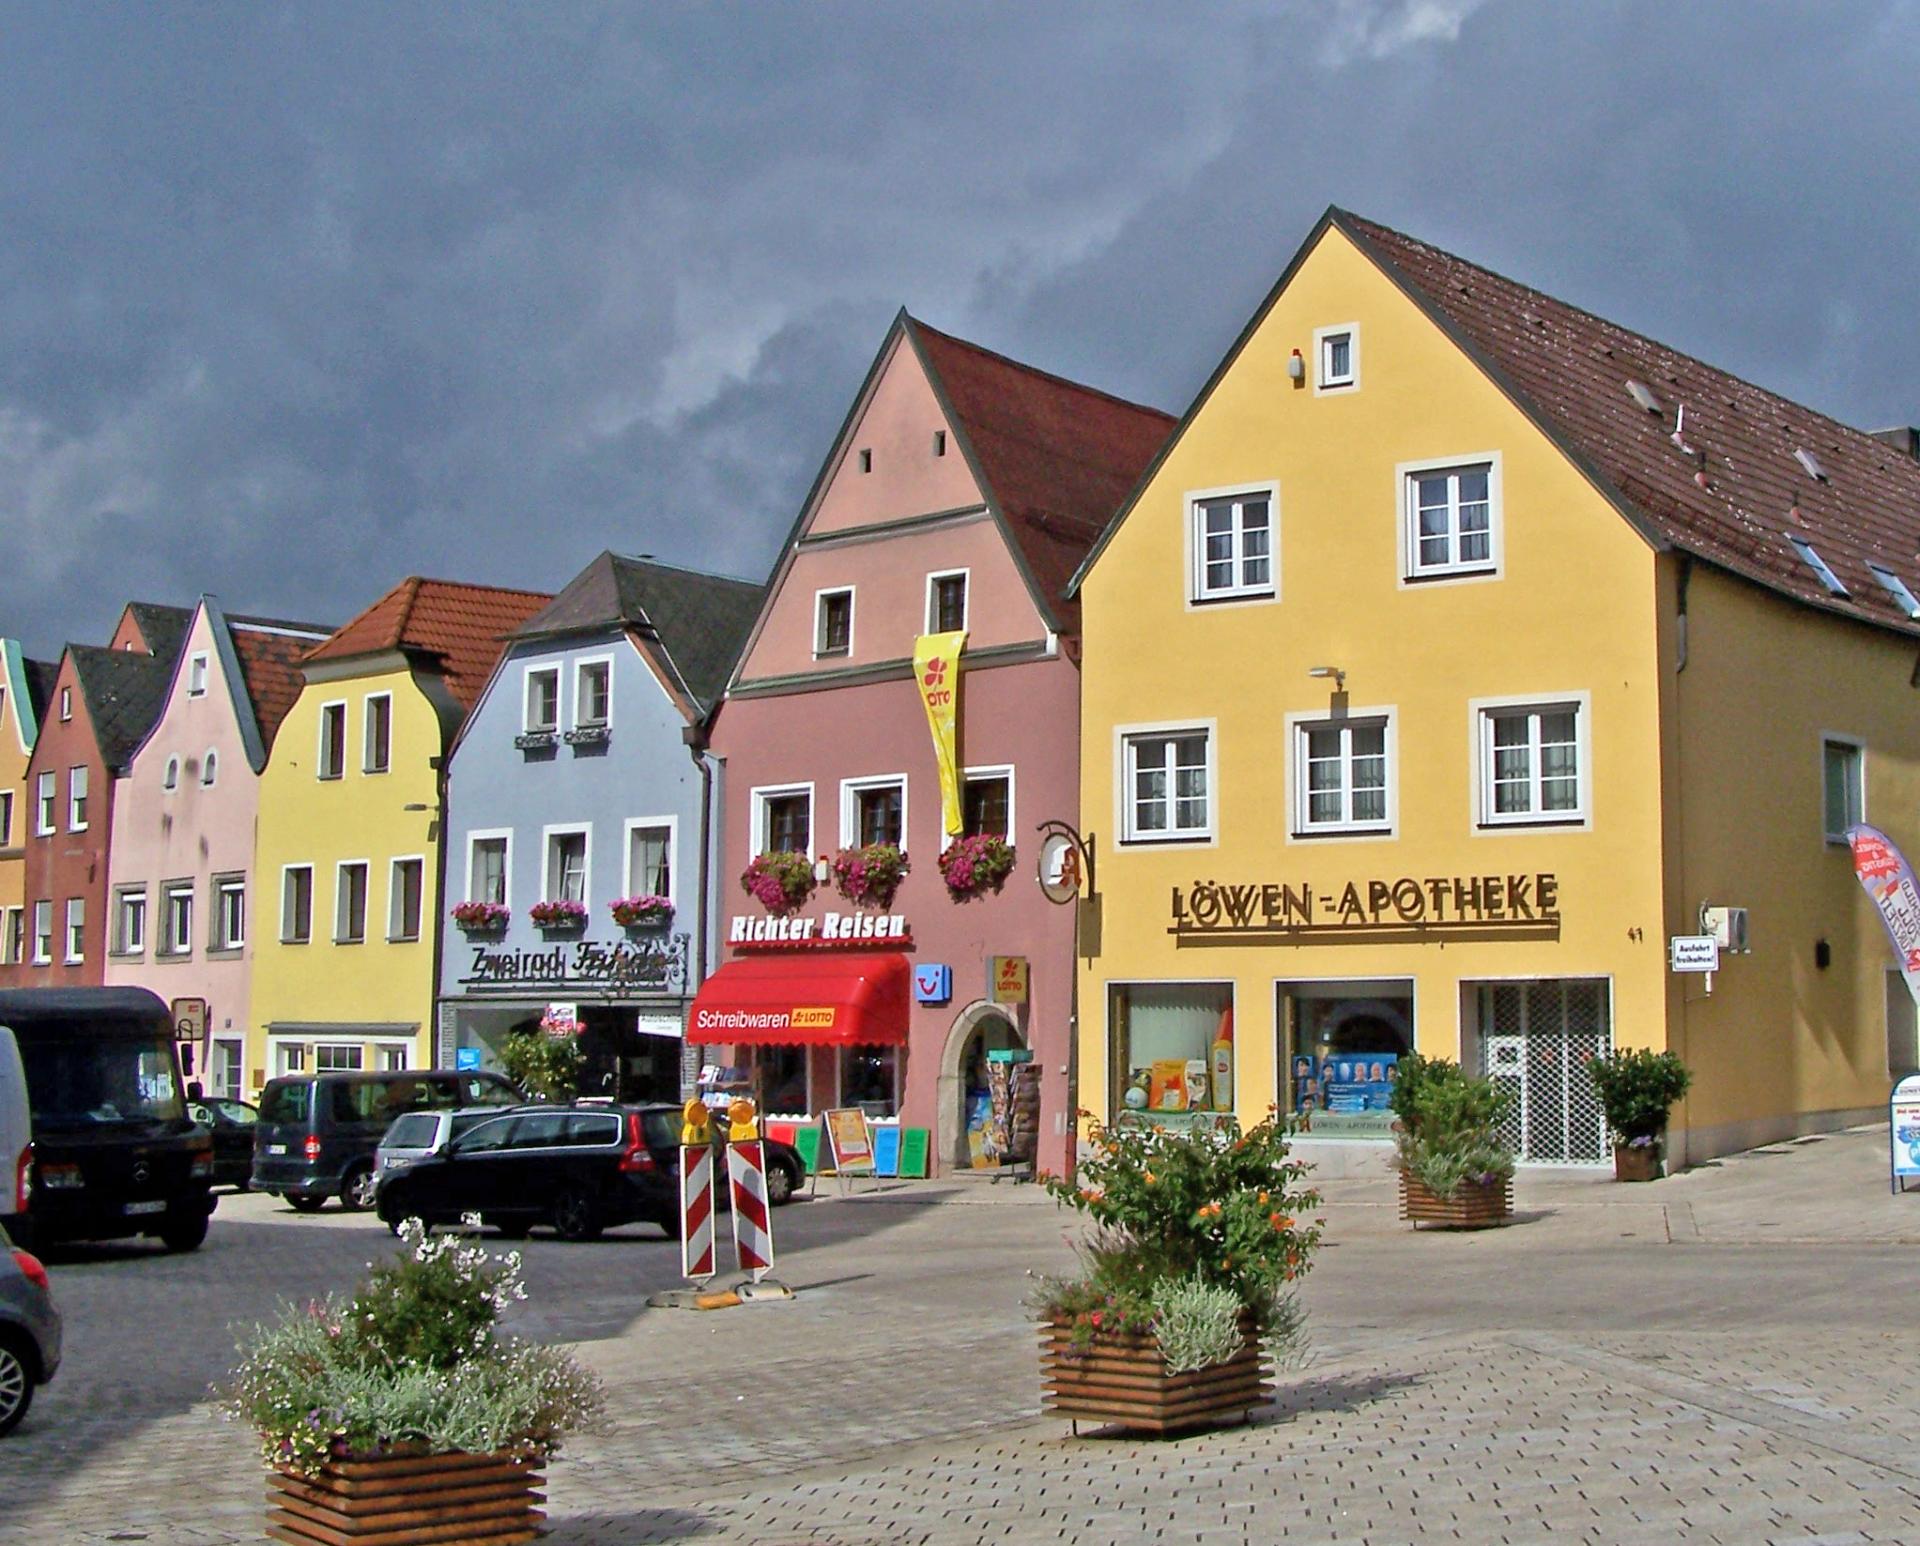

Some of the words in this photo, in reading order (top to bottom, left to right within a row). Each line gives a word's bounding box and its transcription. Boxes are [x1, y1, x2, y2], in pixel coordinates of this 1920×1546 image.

[730, 915, 815, 942] Richter
[821, 911, 905, 939] Reisen
[1627, 927, 1643, 944] 41
[1680, 944, 1710, 952] Ausfahrt
[472, 946, 561, 973] Zweirad
[1676, 955, 1714, 963] freihalten!
[997, 981, 1022, 992] LOTTO
[697, 1009, 790, 1028] Schreibwaren
[804, 1012, 832, 1023] LOTTO
